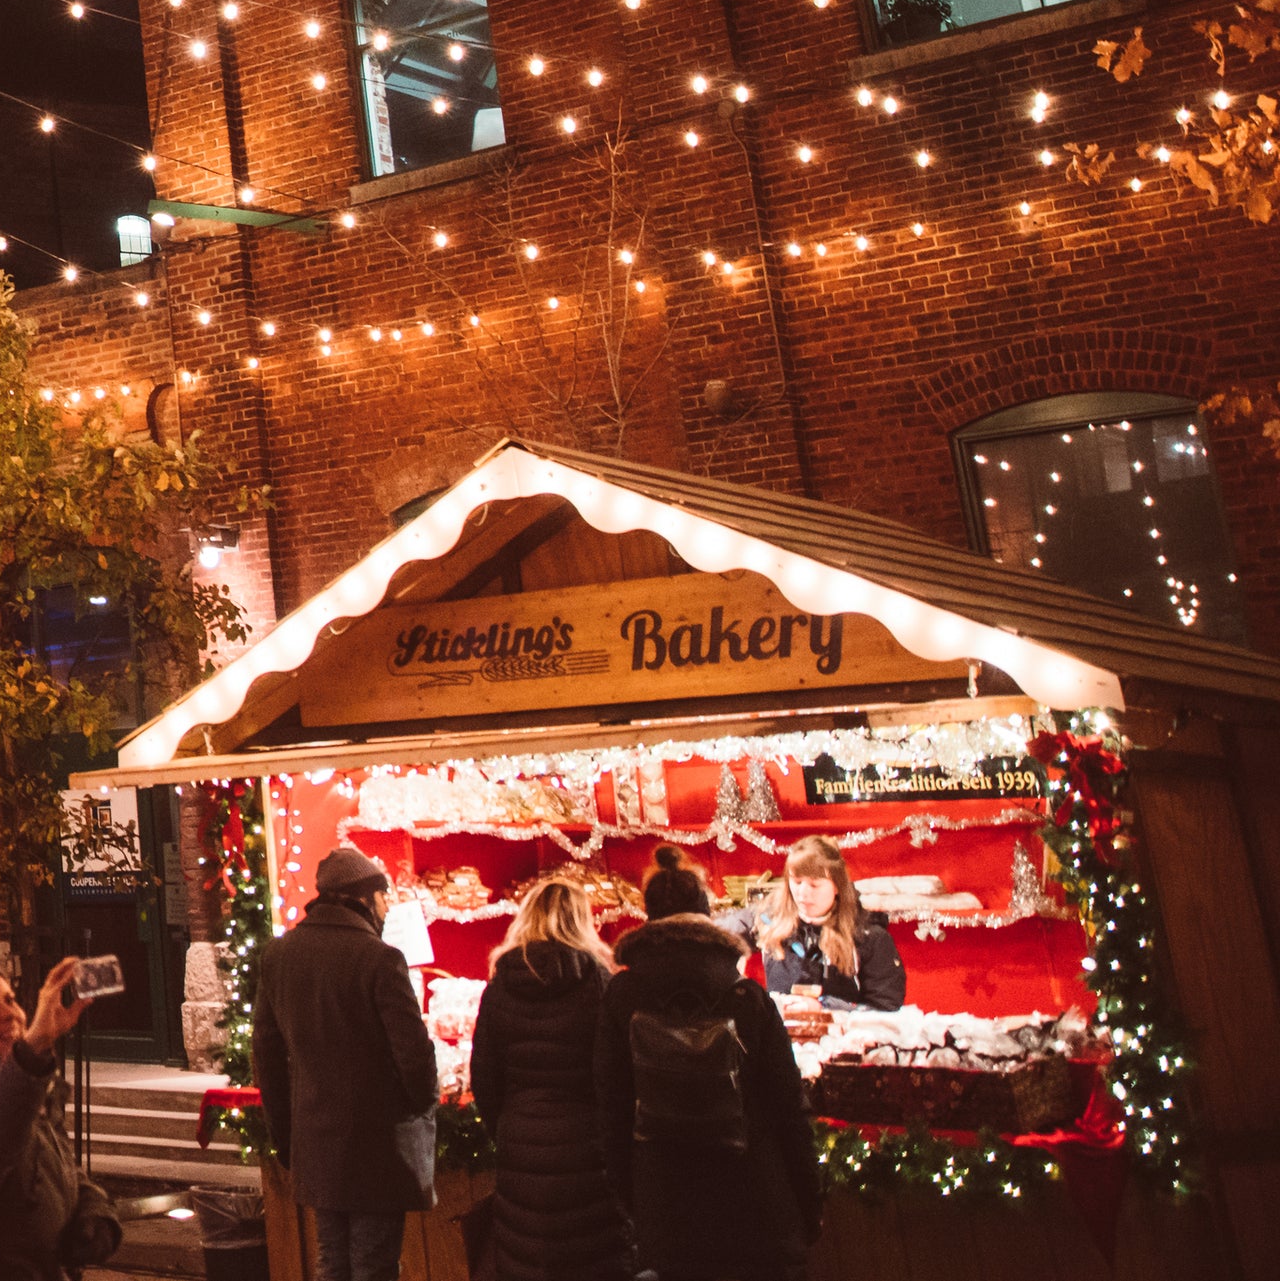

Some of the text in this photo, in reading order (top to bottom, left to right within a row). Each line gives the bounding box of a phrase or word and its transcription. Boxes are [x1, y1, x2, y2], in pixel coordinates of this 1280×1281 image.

[394, 606, 844, 676] Stickling's Bakery
[961, 773, 993, 791] seit
[995, 771, 1036, 791] 1939
